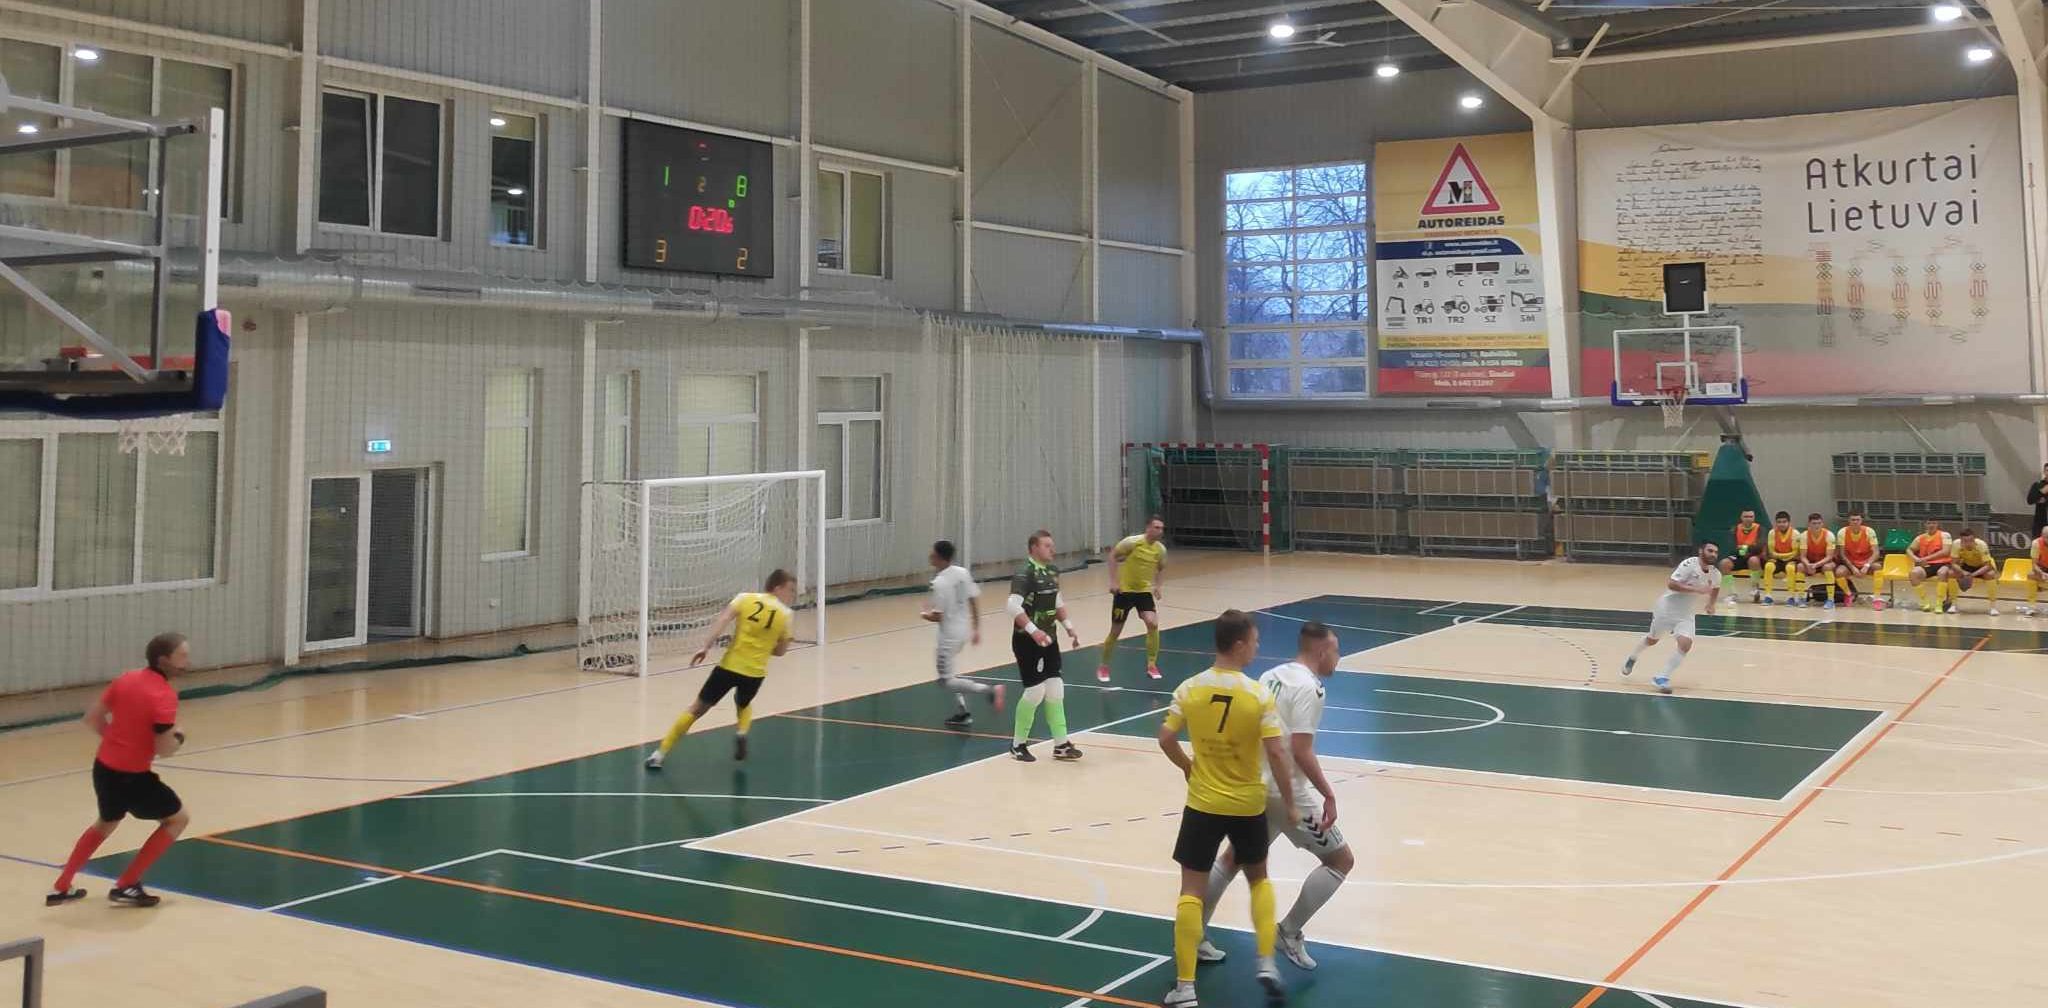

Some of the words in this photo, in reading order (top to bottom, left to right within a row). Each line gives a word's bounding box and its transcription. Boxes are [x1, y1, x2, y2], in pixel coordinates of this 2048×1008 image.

[1806, 144, 1977, 190] Atkurtai
[736, 175, 748, 197] 8
[1417, 215, 1505, 229] AUTOREIDAS
[1807, 189, 1978, 233] Lietuvai
[655, 239, 668, 263] 3
[736, 247, 748, 270] 2
[1481, 278, 1495, 286] CE
[1416, 316, 1433, 324] TR1
[1447, 316, 1465, 324] TR2
[747, 601, 777, 629] 21
[1210, 694, 1234, 733] 7
